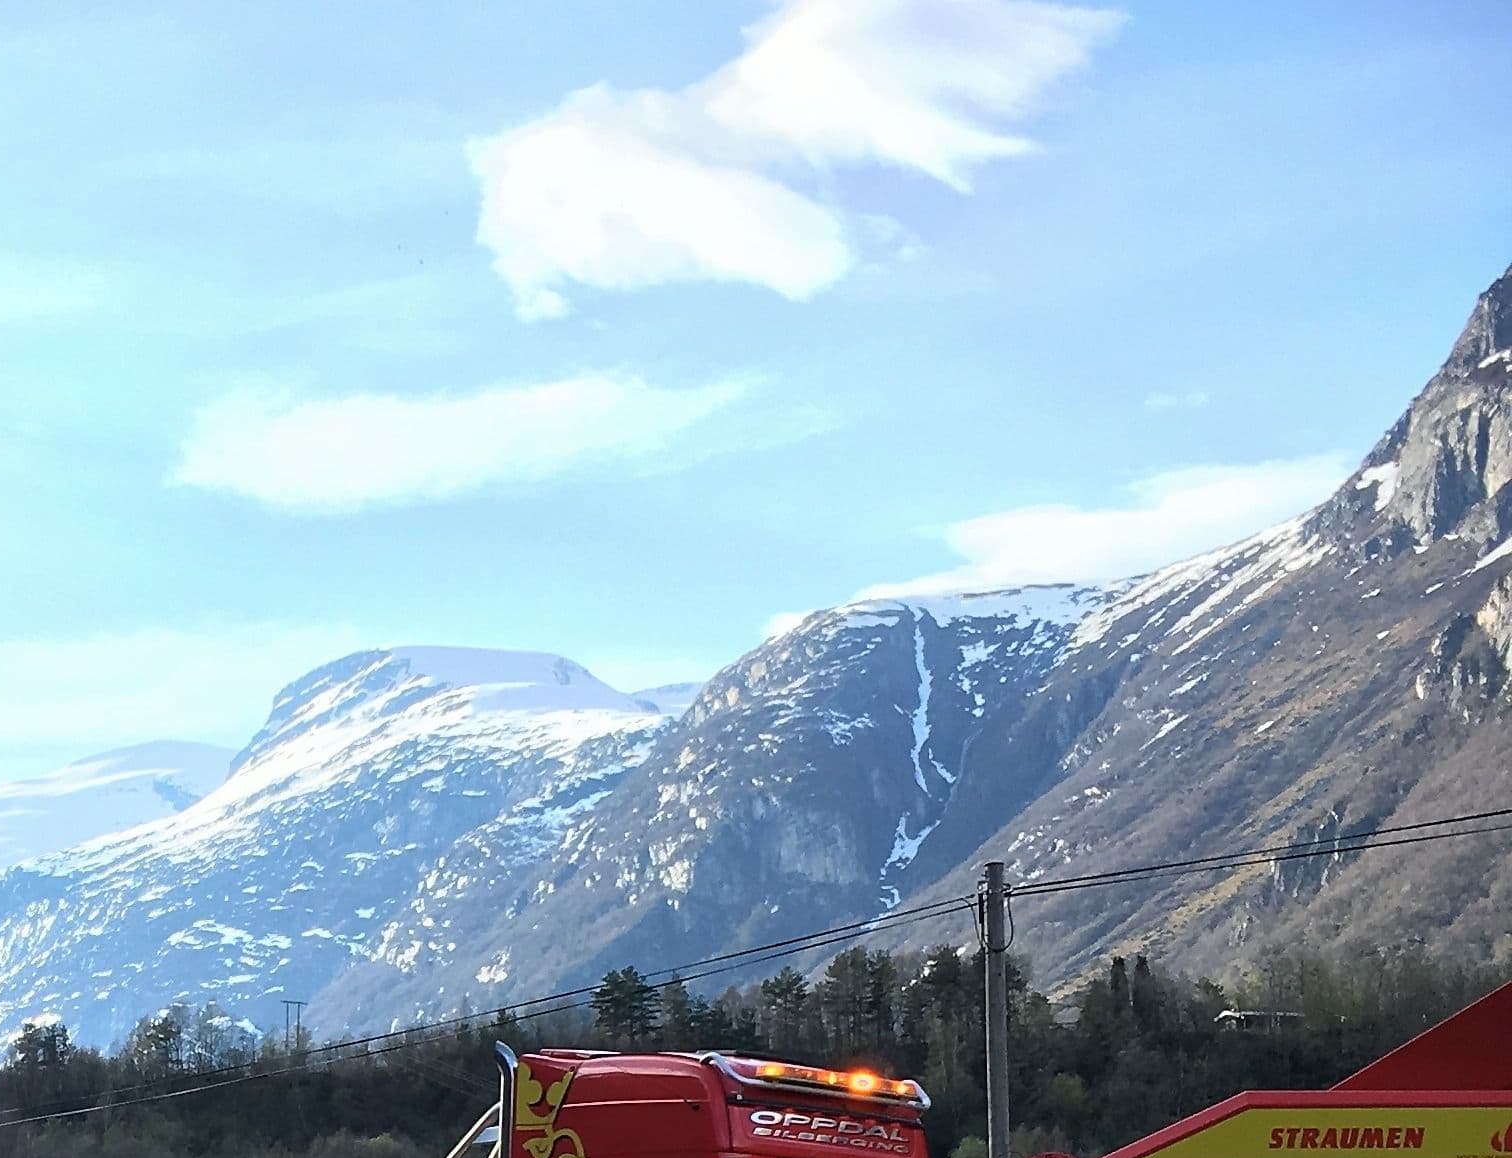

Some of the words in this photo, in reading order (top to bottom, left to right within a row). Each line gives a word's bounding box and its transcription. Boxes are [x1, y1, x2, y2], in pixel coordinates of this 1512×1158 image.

[750, 1110, 909, 1142] OPPDAL
[1268, 1127, 1425, 1149] STRAUMEN
[752, 1127, 909, 1154] BILBERGING
